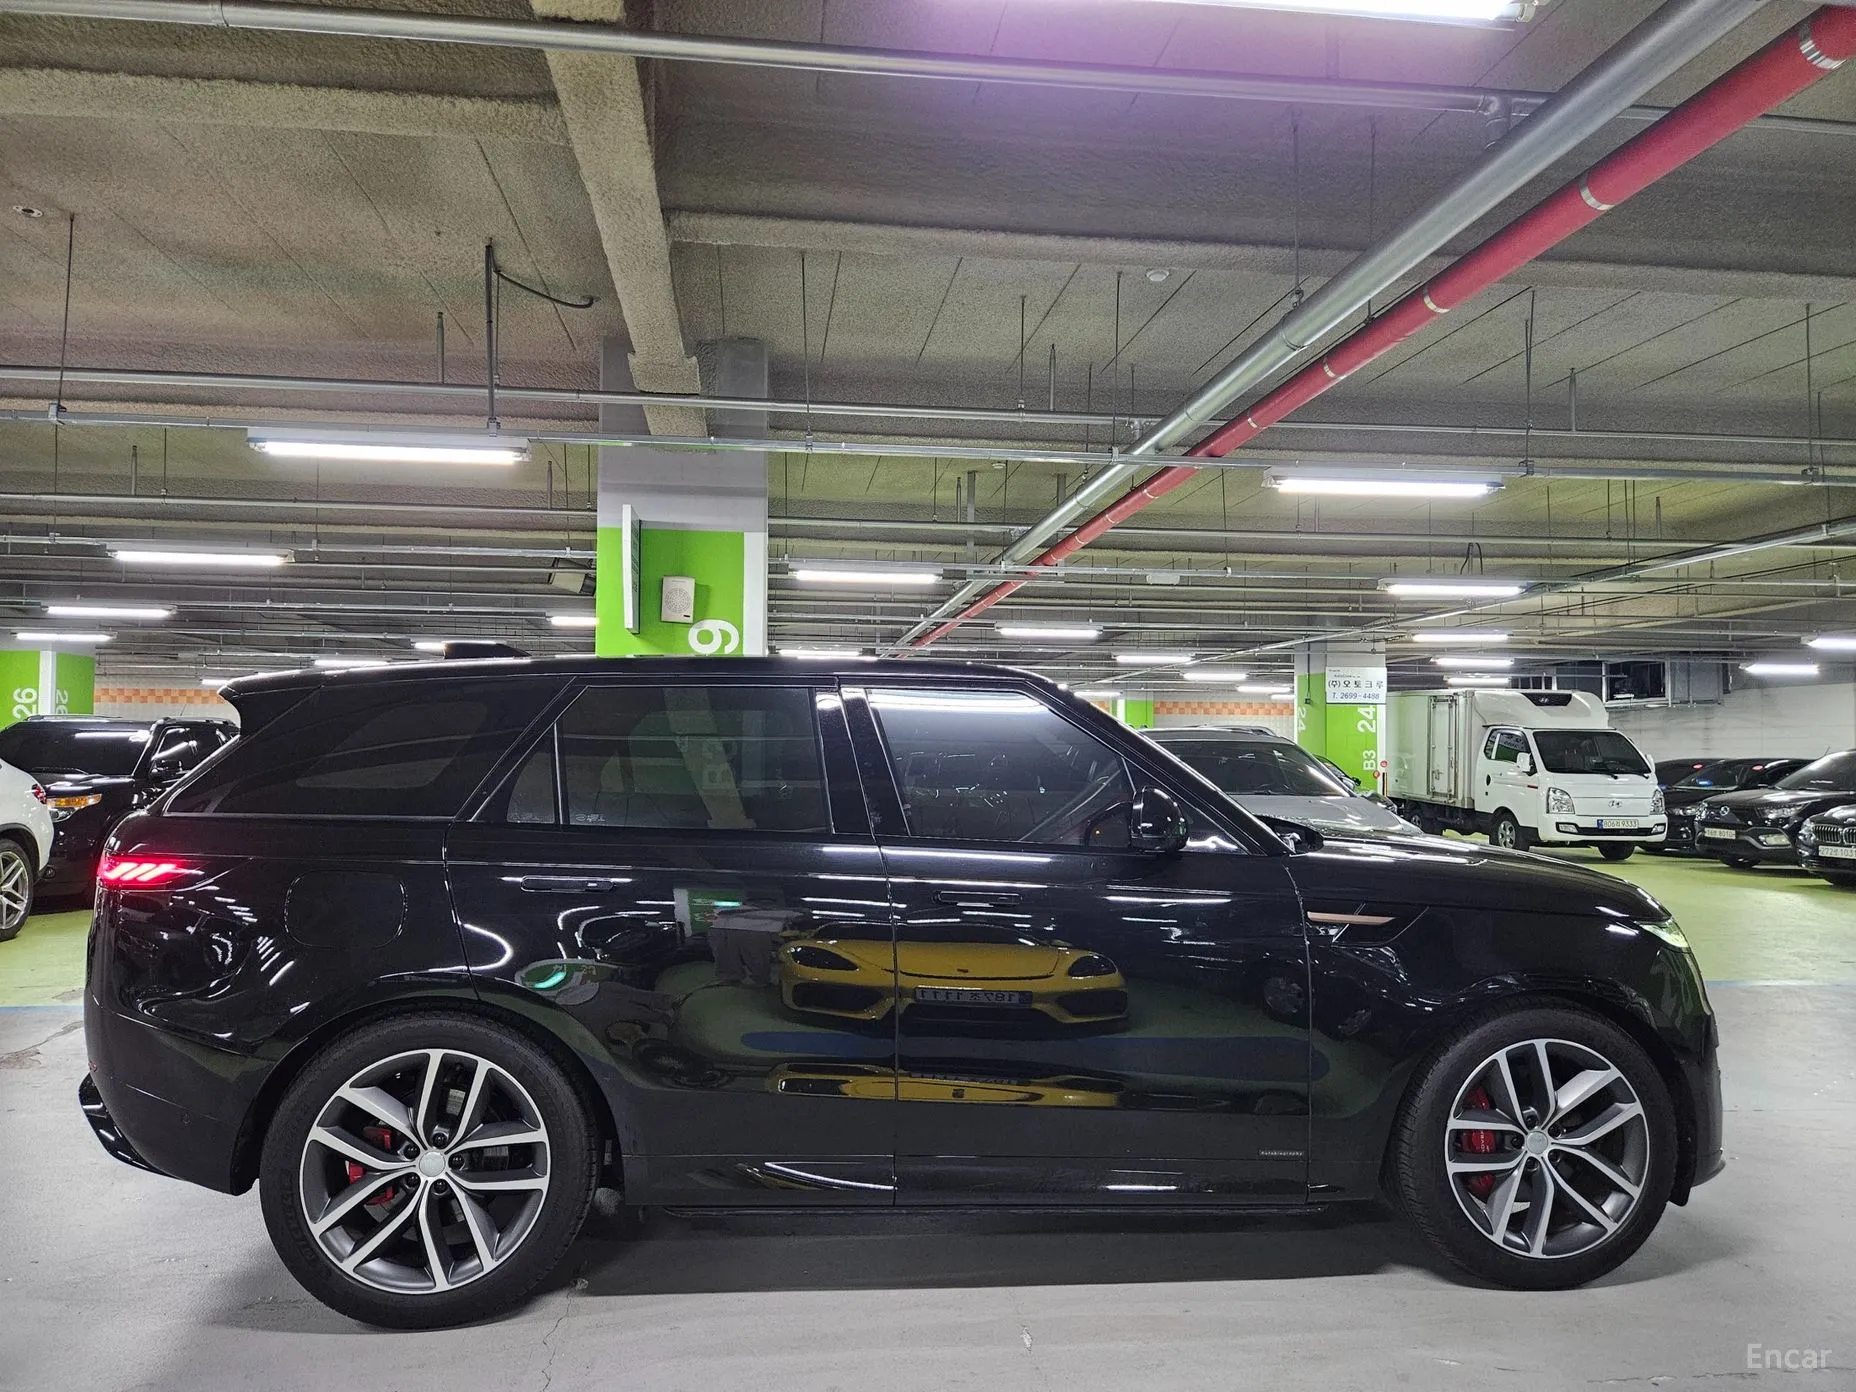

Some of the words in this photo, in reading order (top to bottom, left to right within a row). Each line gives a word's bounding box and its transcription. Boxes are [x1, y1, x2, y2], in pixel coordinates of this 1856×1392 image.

[12, 687, 38, 720] 26
[1357, 704, 1377, 734] 24
[1362, 749, 1377, 771] B3
